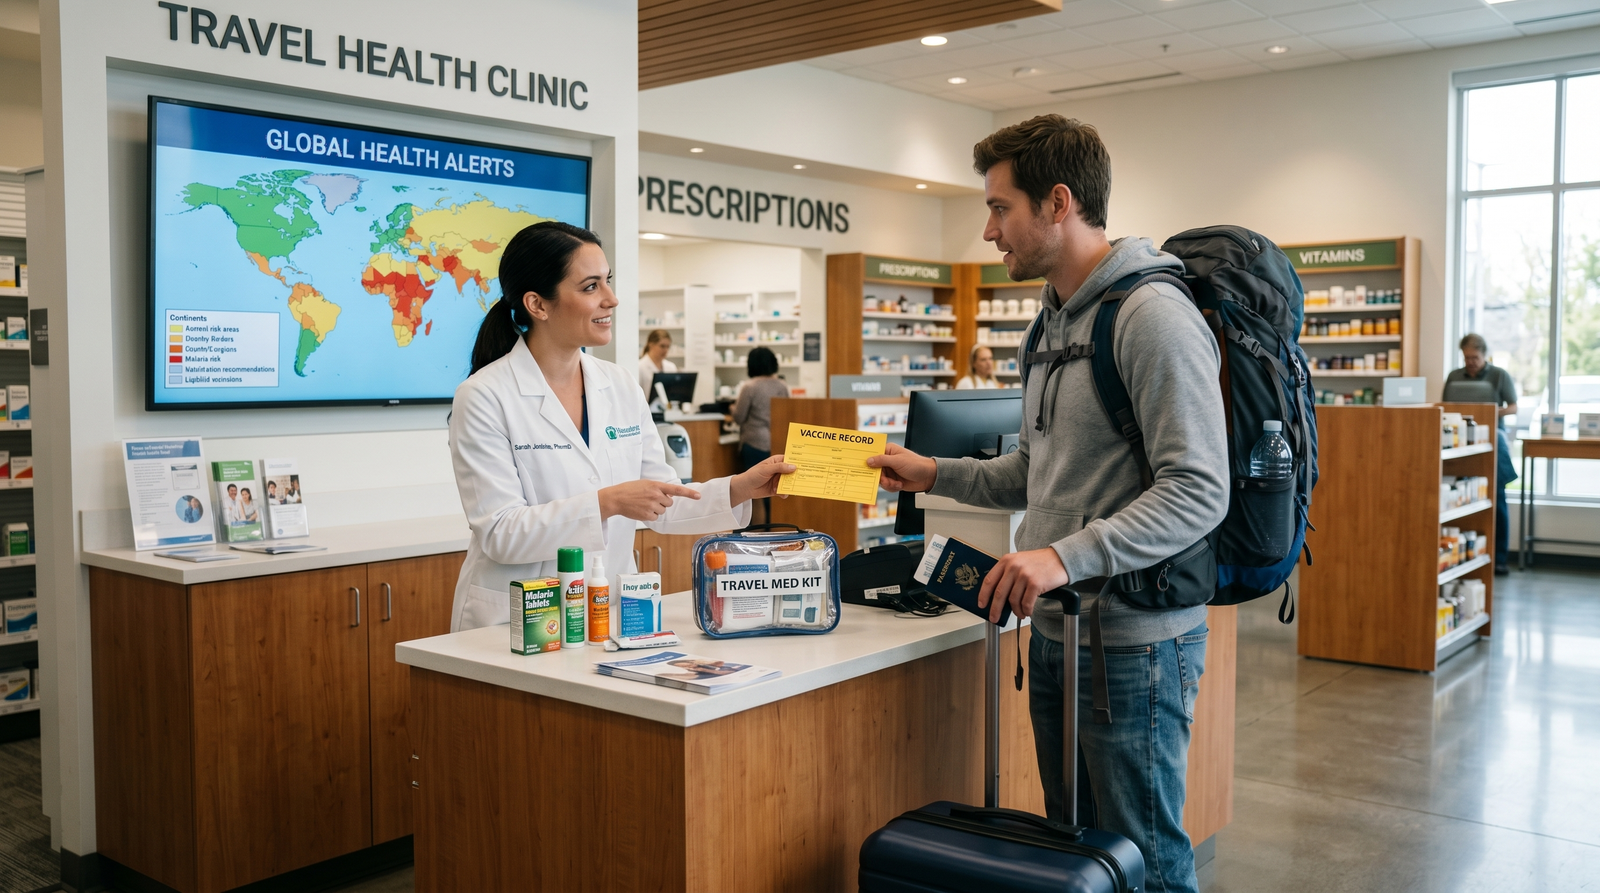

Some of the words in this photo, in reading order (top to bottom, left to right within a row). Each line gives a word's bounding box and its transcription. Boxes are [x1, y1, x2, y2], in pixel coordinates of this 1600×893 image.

[158, 1, 326, 66] TRAVEL
[338, 35, 478, 92] HEALTH
[487, 65, 589, 111] CLINIC
[265, 128, 355, 160] GLOBAL
[360, 140, 440, 170] HEALTH
[444, 151, 515, 178] ALERTS
[1299, 248, 1365, 264] VITAMINS
[878, 262, 940, 280] PRESCRIPTIONS
[800, 429, 837, 441] VACCINE
[838, 433, 874, 445] RECORD
[720, 578, 769, 592] TRAVEL
[771, 577, 799, 590] MED
[802, 576, 822, 588] KIT
[525, 600, 549, 609] Tablets
